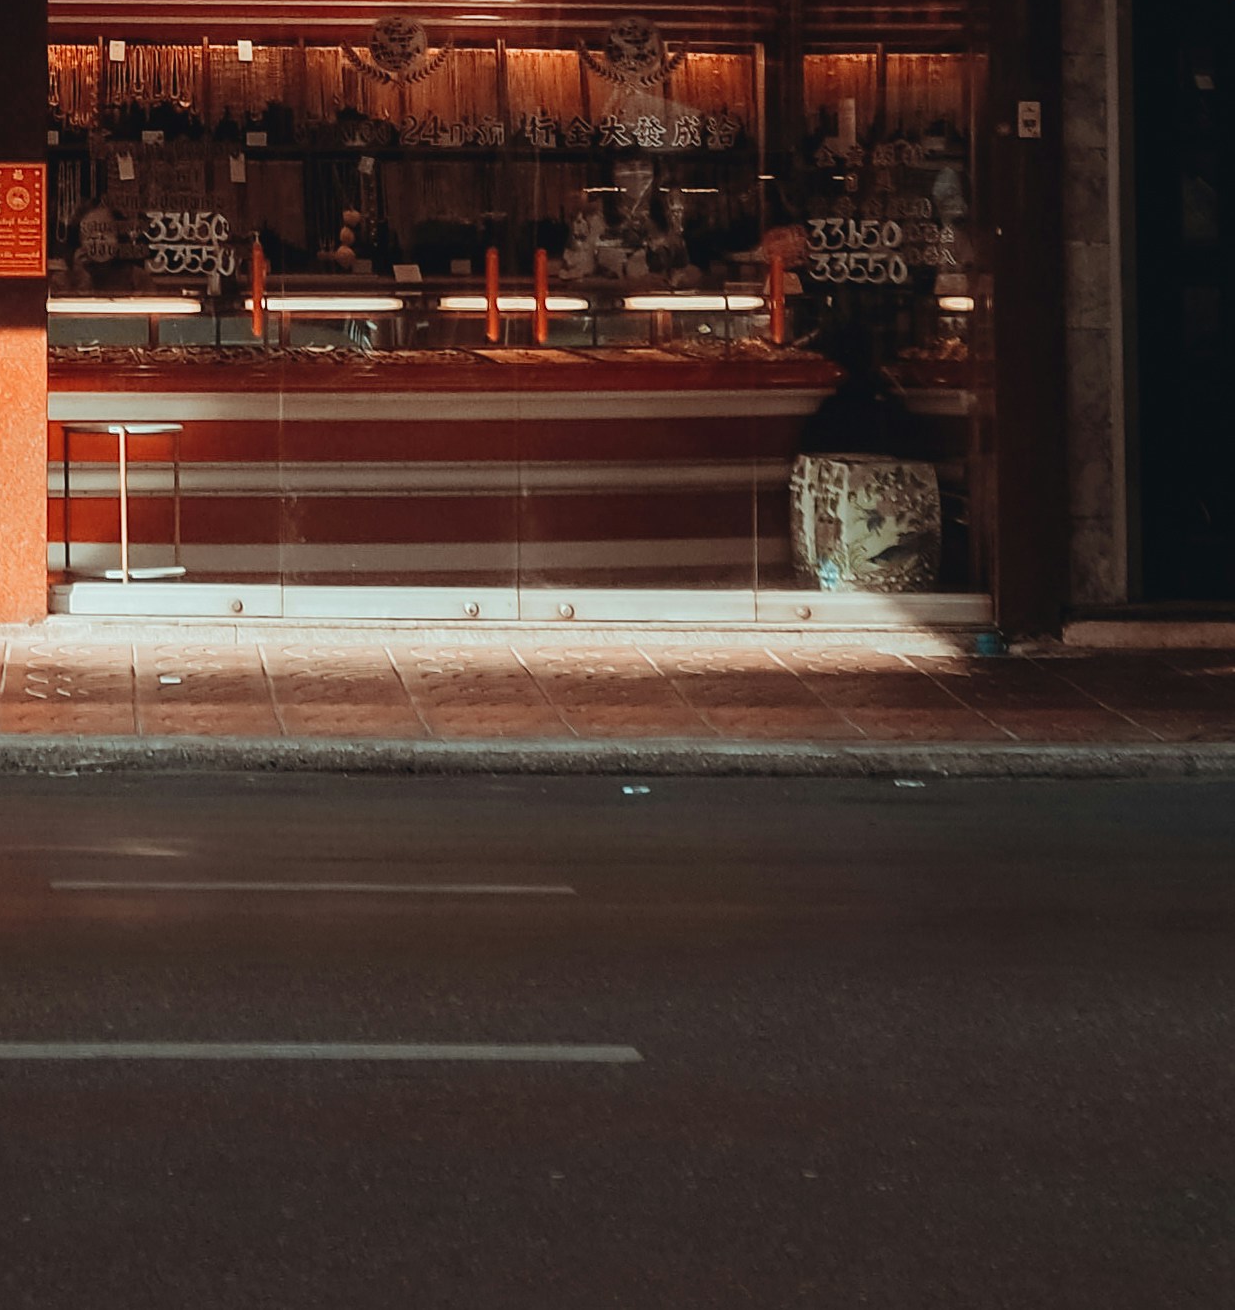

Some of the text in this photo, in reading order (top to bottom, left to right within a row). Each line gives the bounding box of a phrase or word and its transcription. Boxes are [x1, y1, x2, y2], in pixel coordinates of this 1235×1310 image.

[399, 115, 442, 146] 24
[806, 218, 904, 250] 33650
[809, 252, 909, 284] 33550
